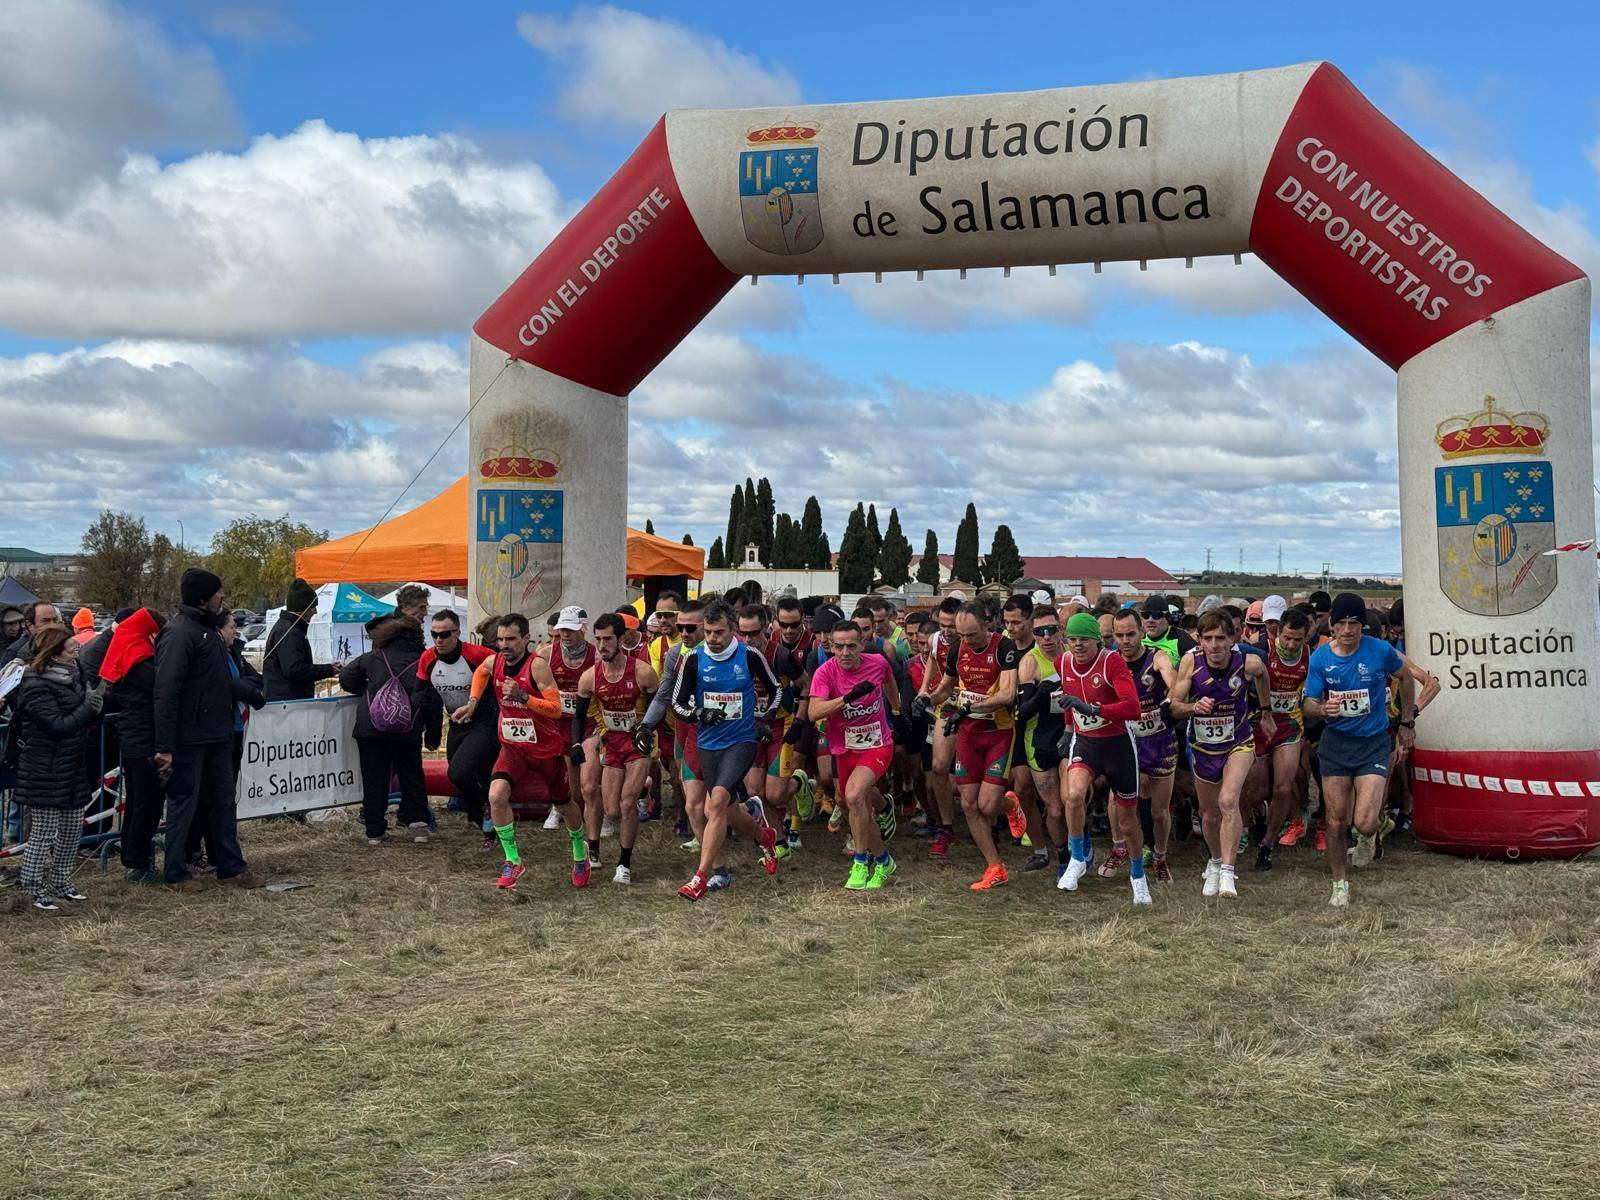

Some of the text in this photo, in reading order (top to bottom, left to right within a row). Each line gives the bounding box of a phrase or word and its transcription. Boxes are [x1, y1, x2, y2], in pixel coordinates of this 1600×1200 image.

[852, 104, 1149, 177] Diputación
[852, 180, 1210, 238] de Salamanca
[1296, 136, 1494, 298] CON NUESTROS
[1274, 175, 1450, 322] DEPORTISTAS
[518, 186, 671, 347] CON EL DEPORTE
[1429, 627, 1574, 662] Diputación
[1449, 663, 1588, 690] Salamanca
[1274, 700, 1289, 708] 66
[1341, 700, 1359, 711] 13
[511, 726, 527, 737] 26
[613, 719, 627, 727] 51
[1080, 715, 1098, 725] 23
[1137, 720, 1155, 731] 30
[1206, 726, 1224, 737] 33
[248, 734, 337, 767] Diputación
[856, 732, 872, 744] 24
[247, 769, 354, 799] de Salamanca
